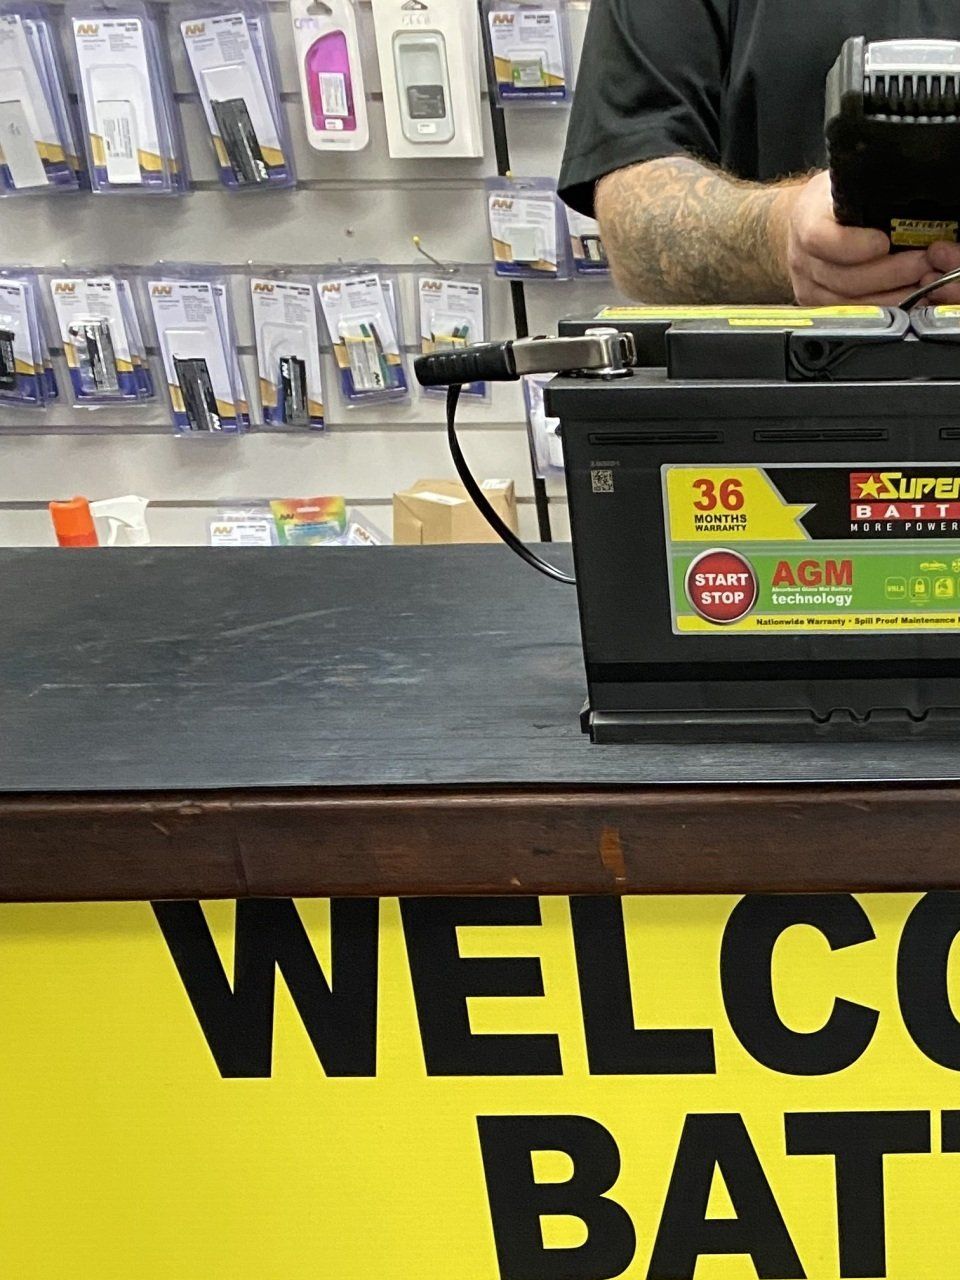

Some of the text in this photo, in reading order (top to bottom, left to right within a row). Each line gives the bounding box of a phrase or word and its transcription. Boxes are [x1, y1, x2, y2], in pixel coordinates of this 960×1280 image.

[692, 478, 745, 512] 36
[694, 514, 747, 524] MONTHS
[695, 524, 747, 532] WARRANTY
[850, 522, 893, 531] MORE
[695, 573, 749, 587] START
[771, 559, 853, 587] AGM
[701, 591, 745, 605] STOP
[771, 592, 853, 607] technology
[756, 618, 805, 626] Nationwide
[807, 618, 846, 627] Warranty
[855, 616, 873, 626] Spill
[876, 617, 898, 625] Proof
[901, 616, 956, 624] Maintenance
